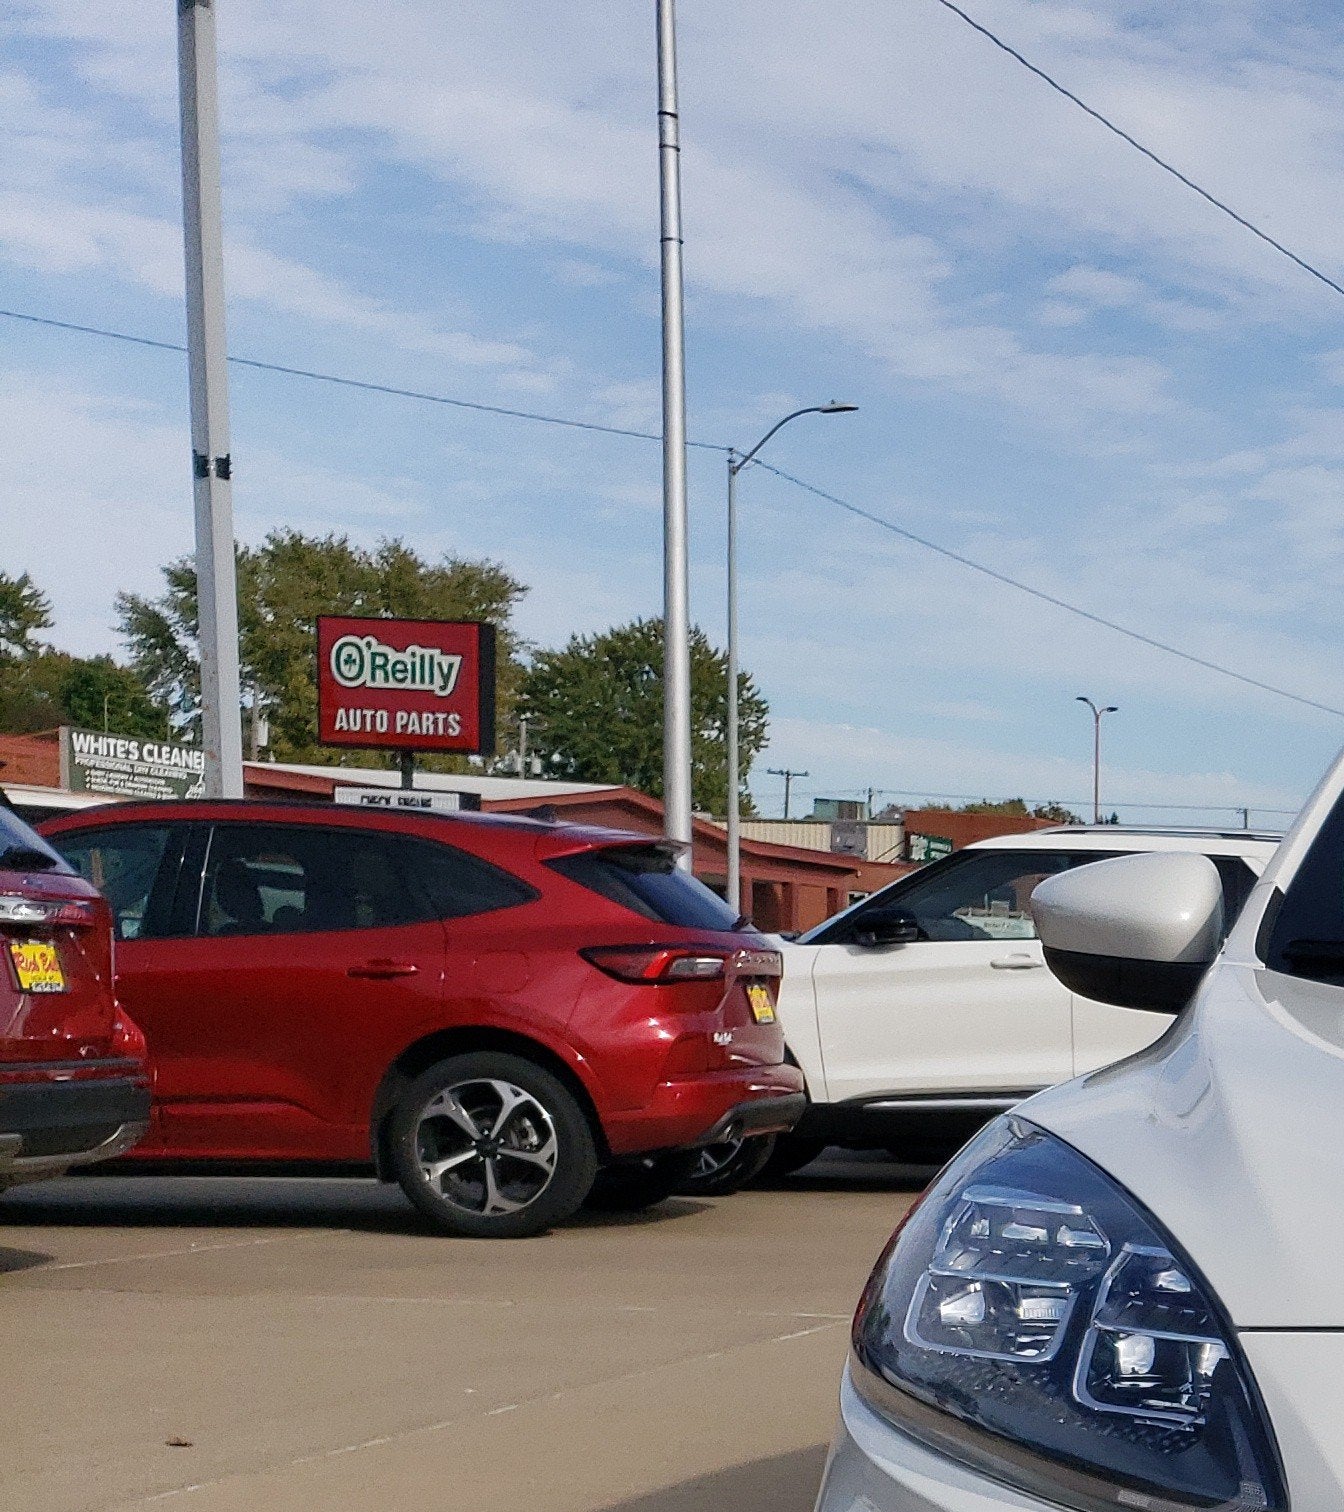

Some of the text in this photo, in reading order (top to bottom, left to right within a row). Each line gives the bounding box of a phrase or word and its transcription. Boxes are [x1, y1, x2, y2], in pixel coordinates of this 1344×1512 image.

[334, 638, 458, 693] O'Reilly
[334, 707, 462, 737] AUTO PARTS
[72, 731, 140, 761] WHITE'S
